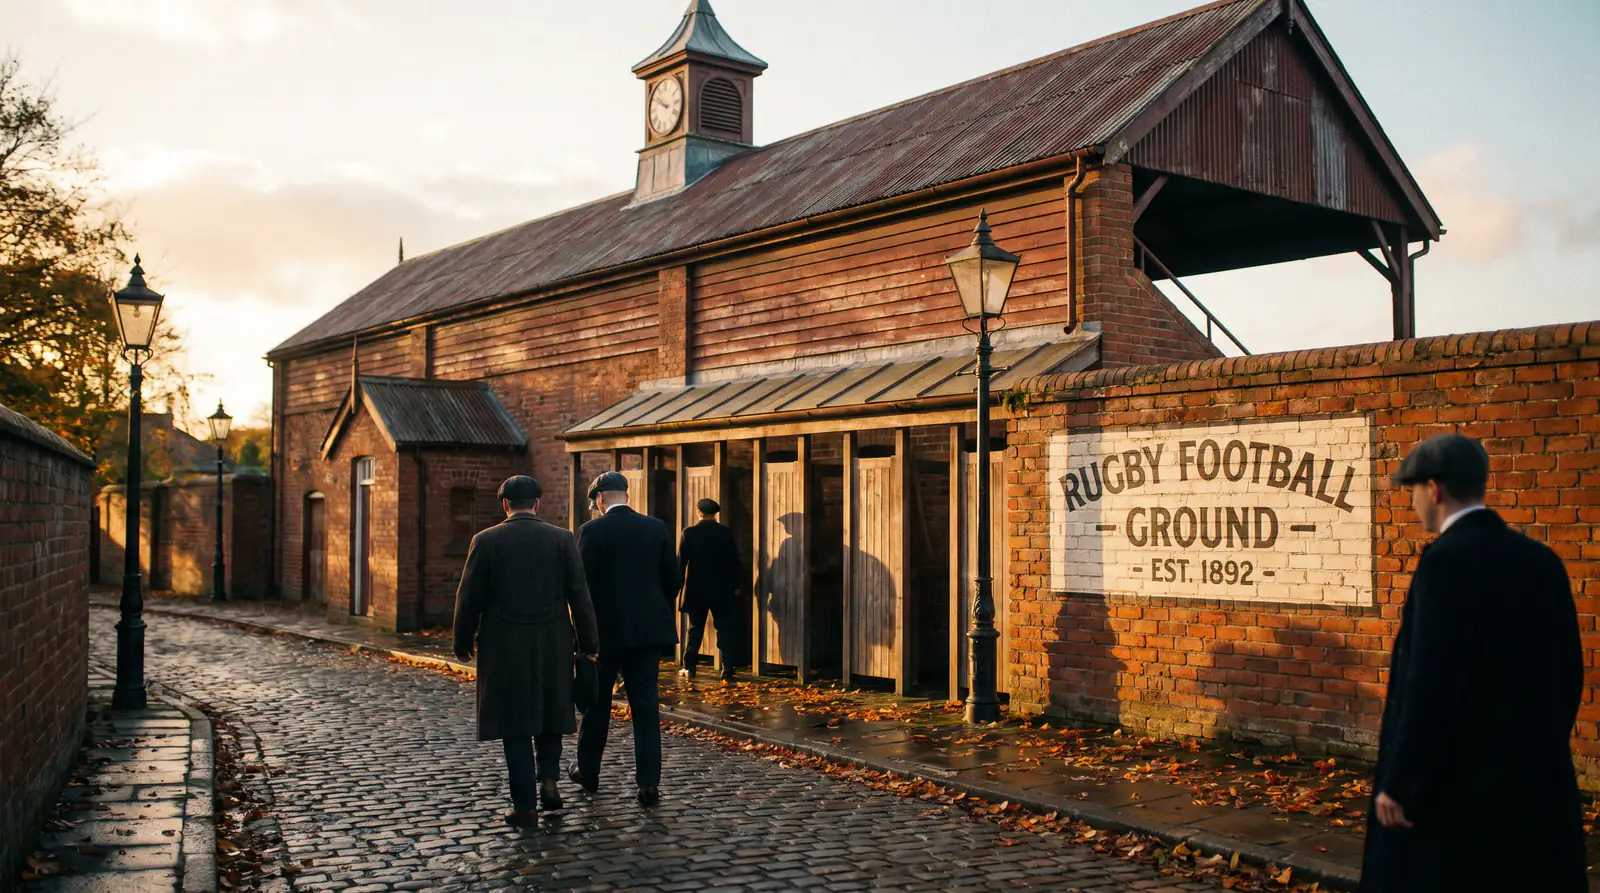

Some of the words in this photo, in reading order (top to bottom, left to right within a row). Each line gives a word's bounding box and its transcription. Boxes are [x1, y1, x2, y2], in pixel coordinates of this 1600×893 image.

[1059, 443, 1165, 512] RUGBY
[1178, 439, 1356, 513] FOOTBALL
[1125, 506, 1279, 549] GROUND
[1151, 558, 1193, 583] EST.
[1201, 559, 1254, 585] 1892
